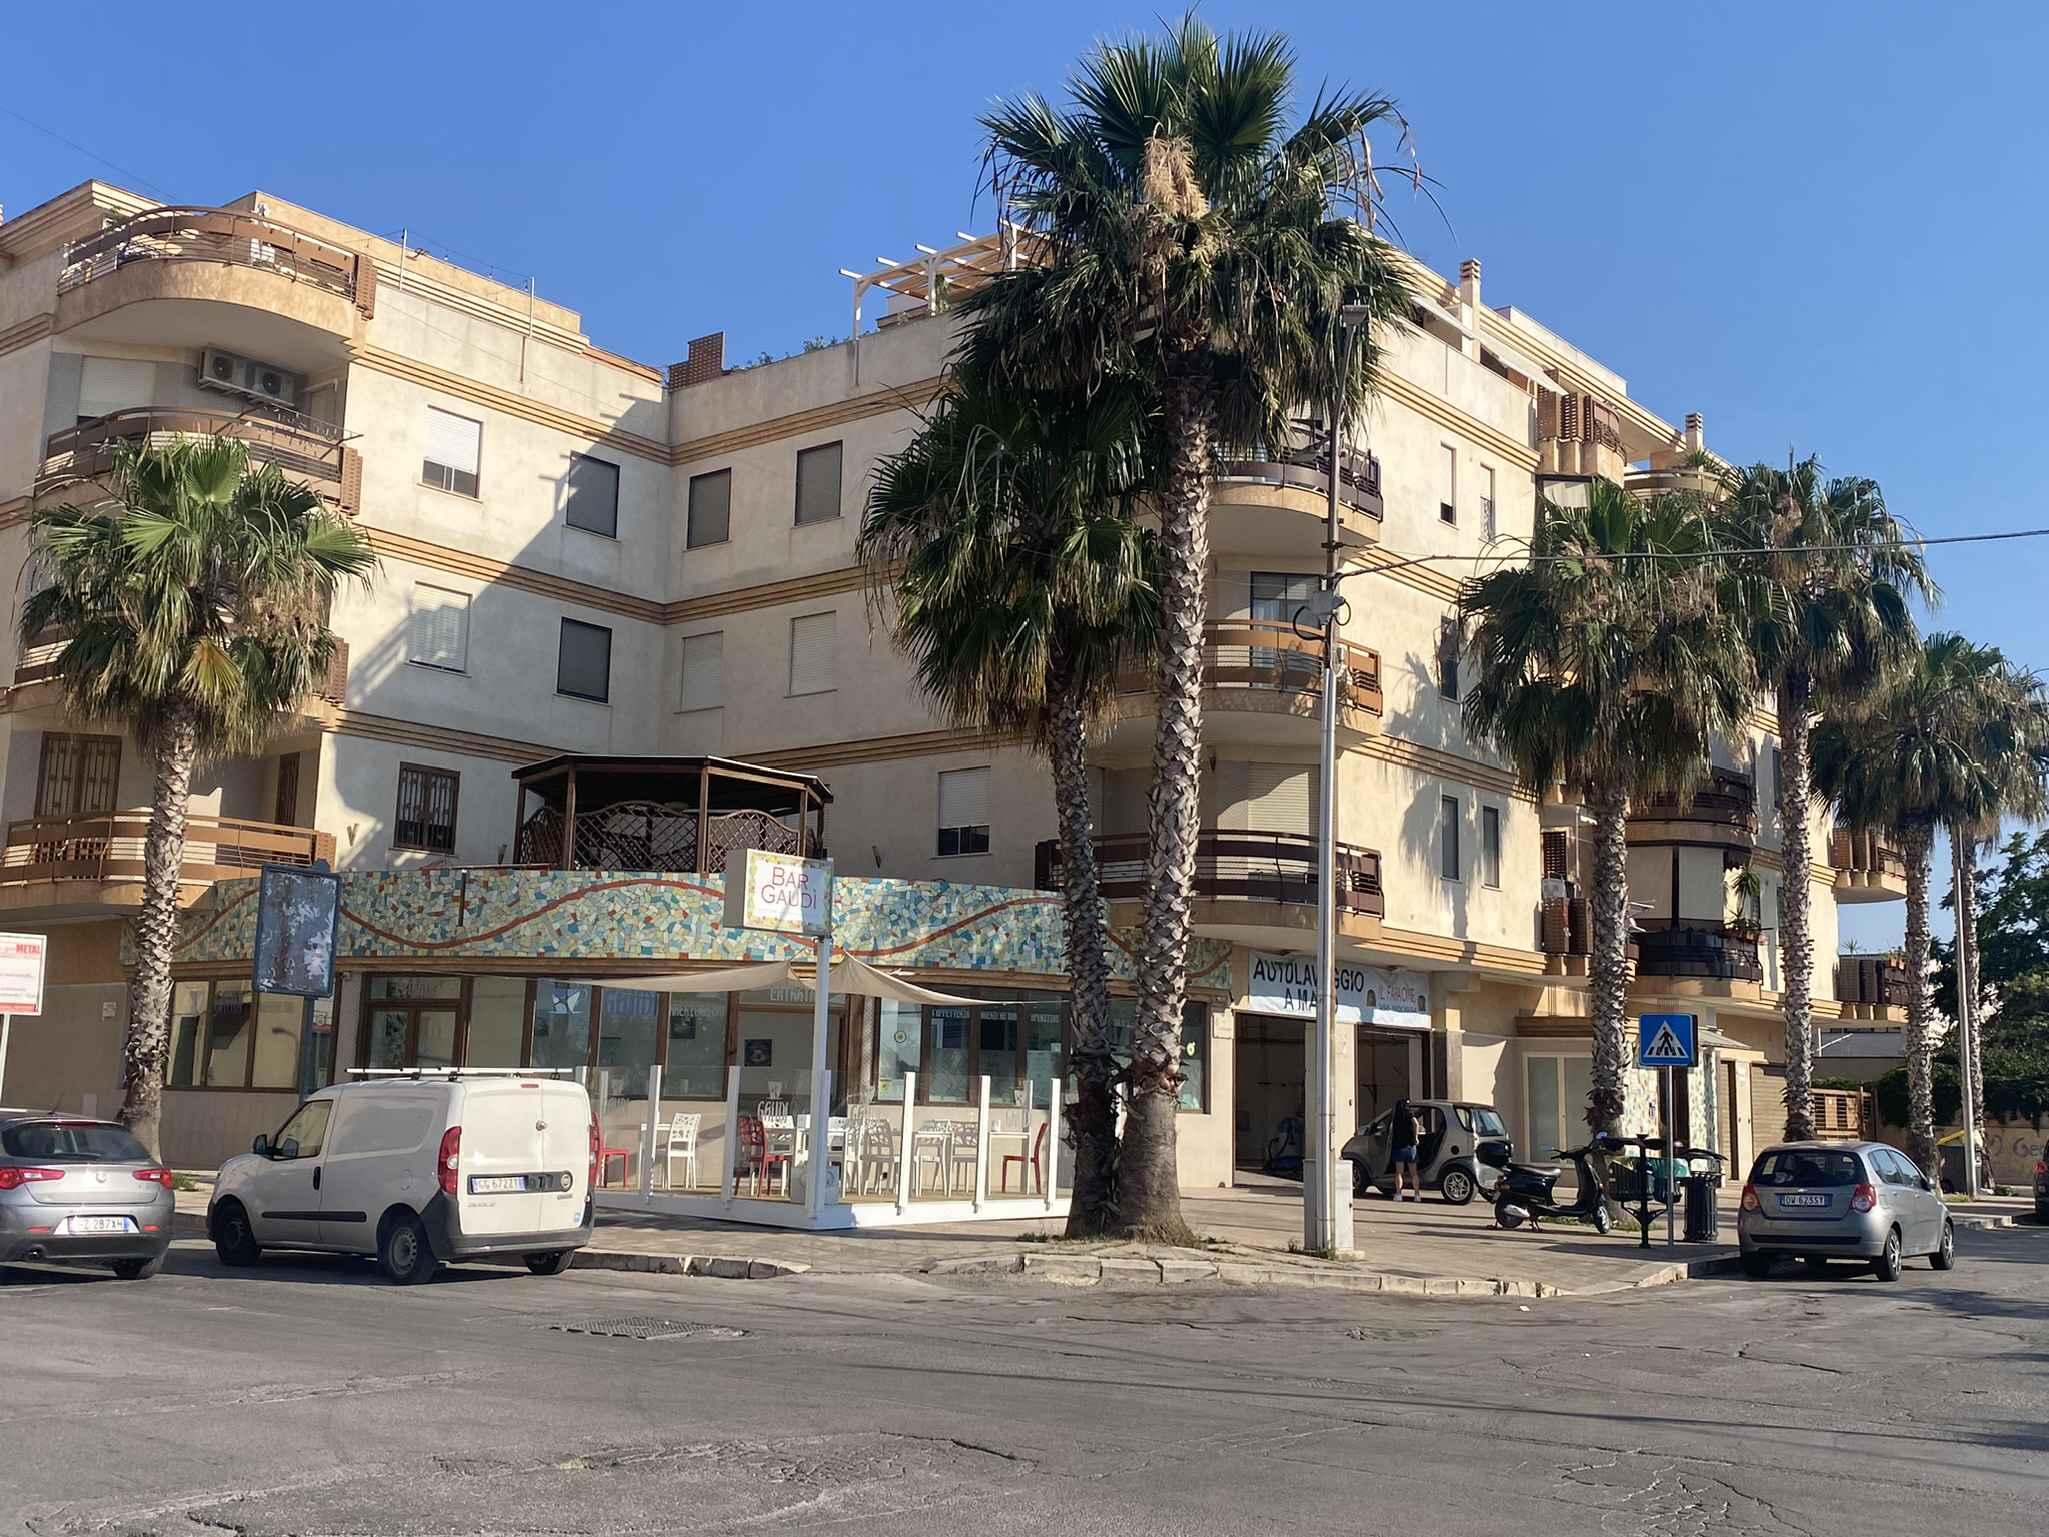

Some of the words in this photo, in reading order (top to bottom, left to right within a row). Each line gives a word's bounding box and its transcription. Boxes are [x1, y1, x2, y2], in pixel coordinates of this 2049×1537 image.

[772, 866, 809, 890] BAR
[1253, 958, 1365, 993] AUTOLAVGGIO
[1284, 988, 1294, 1010] A
